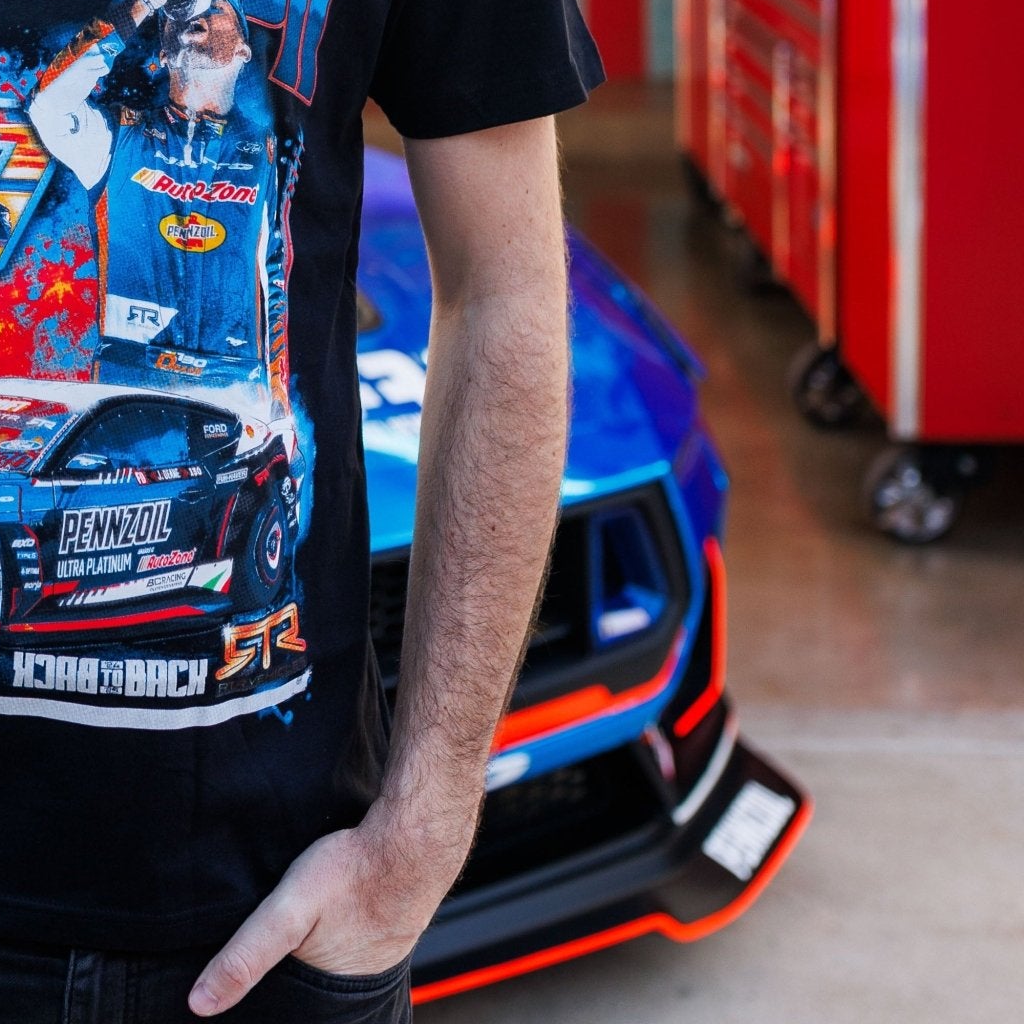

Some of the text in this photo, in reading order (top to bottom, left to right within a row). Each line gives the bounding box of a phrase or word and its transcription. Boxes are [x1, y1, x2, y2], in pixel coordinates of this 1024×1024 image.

[152, 174, 260, 205] AutoZone
[167, 225, 217, 239] PENNZOIL
[203, 423, 228, 434] FORD
[59, 499, 172, 555] PENNZOIL
[57, 553, 132, 578] ULTRA PLATINUM
[146, 550, 195, 571] AutoZone
[101, 669, 124, 687] TO
[124, 658, 208, 697] BACK
